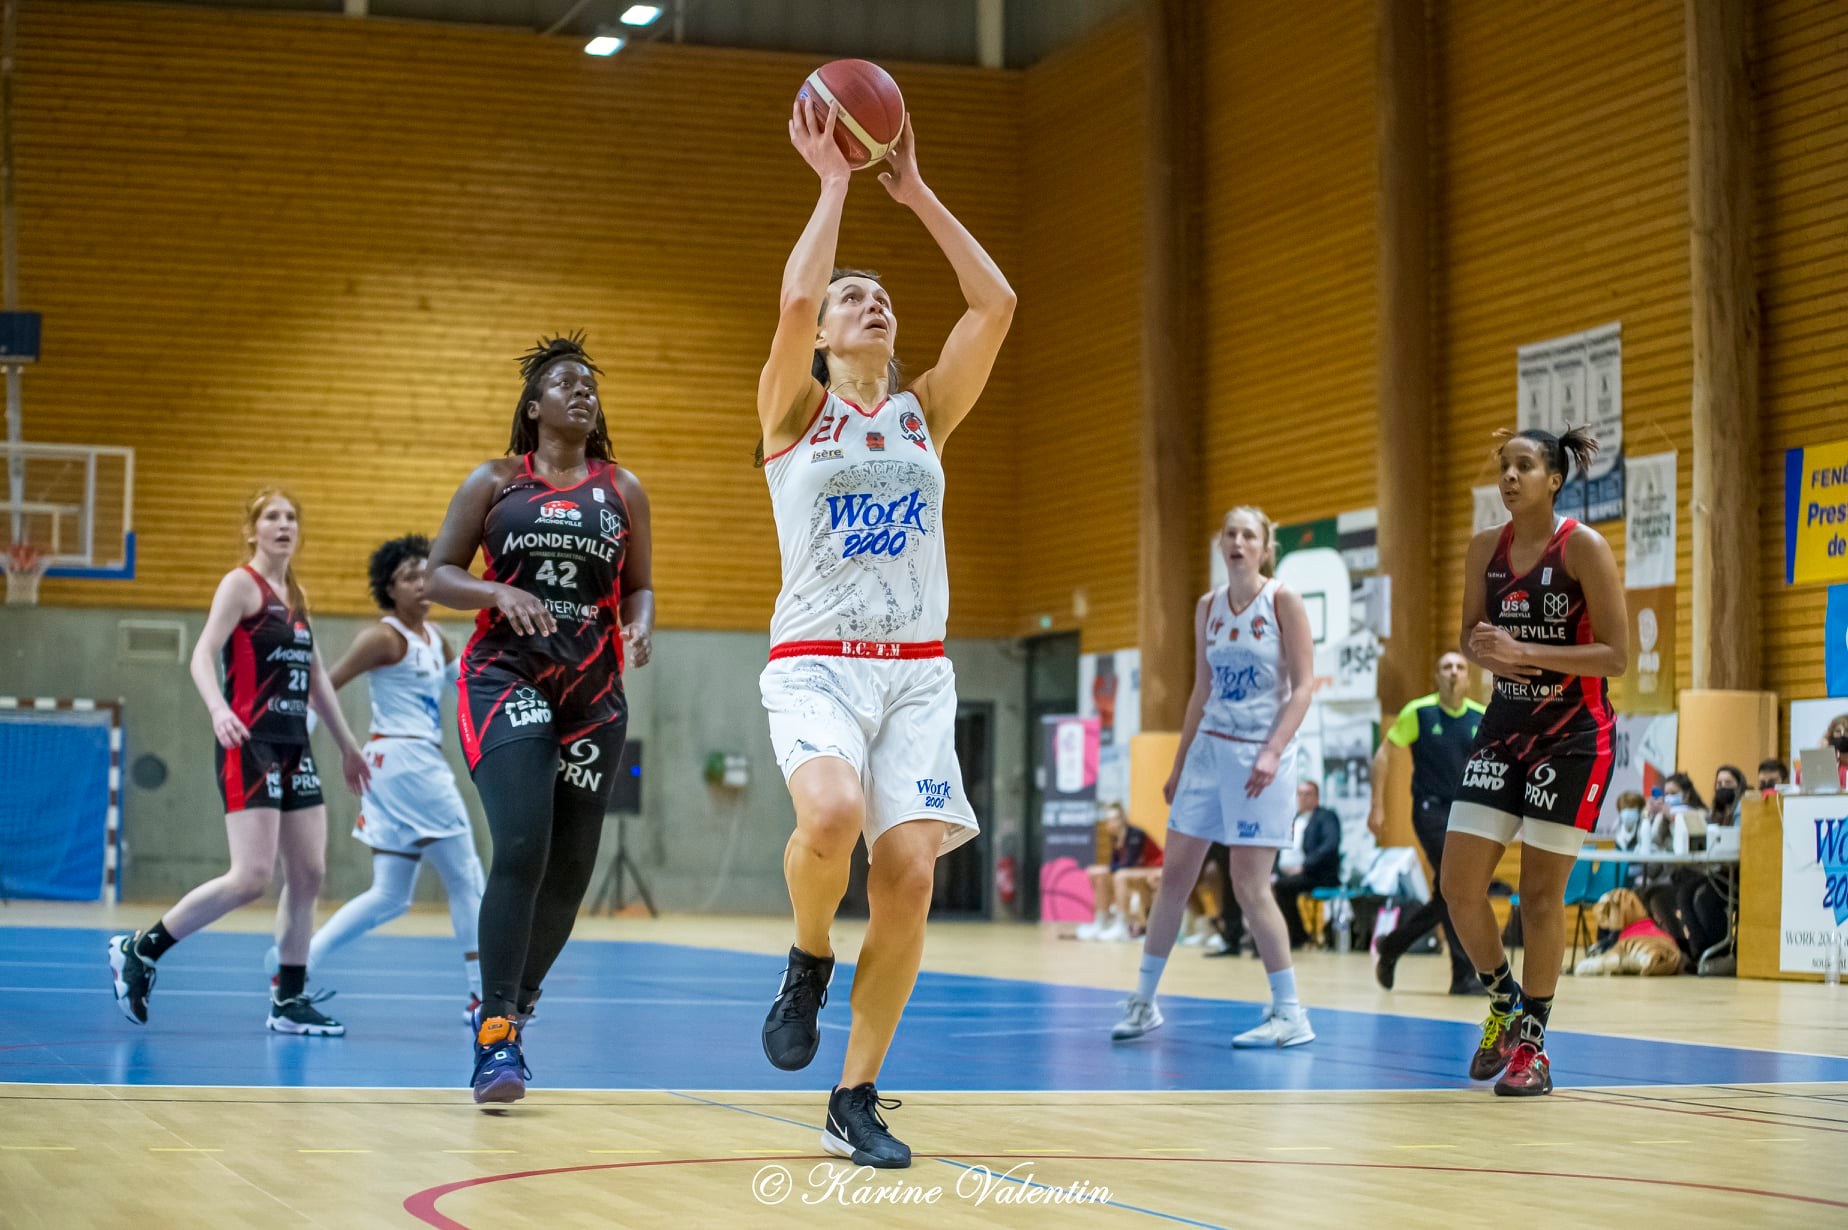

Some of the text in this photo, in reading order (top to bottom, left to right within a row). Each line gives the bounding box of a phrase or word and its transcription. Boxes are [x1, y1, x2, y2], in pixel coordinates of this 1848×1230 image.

[810, 414, 850, 445] 21
[812, 448, 843, 460] isère
[826, 487, 927, 536] Work
[502, 531, 615, 563] MONDEVILLE
[842, 528, 906, 559] 2000
[535, 559, 578, 589] 42
[509, 708, 553, 728] LAND
[1465, 759, 1509, 777] FESTY
[916, 778, 952, 800] Work
[1462, 773, 1506, 791] LAND
[925, 795, 945, 809] 2000
[1524, 781, 1559, 810] PRN
